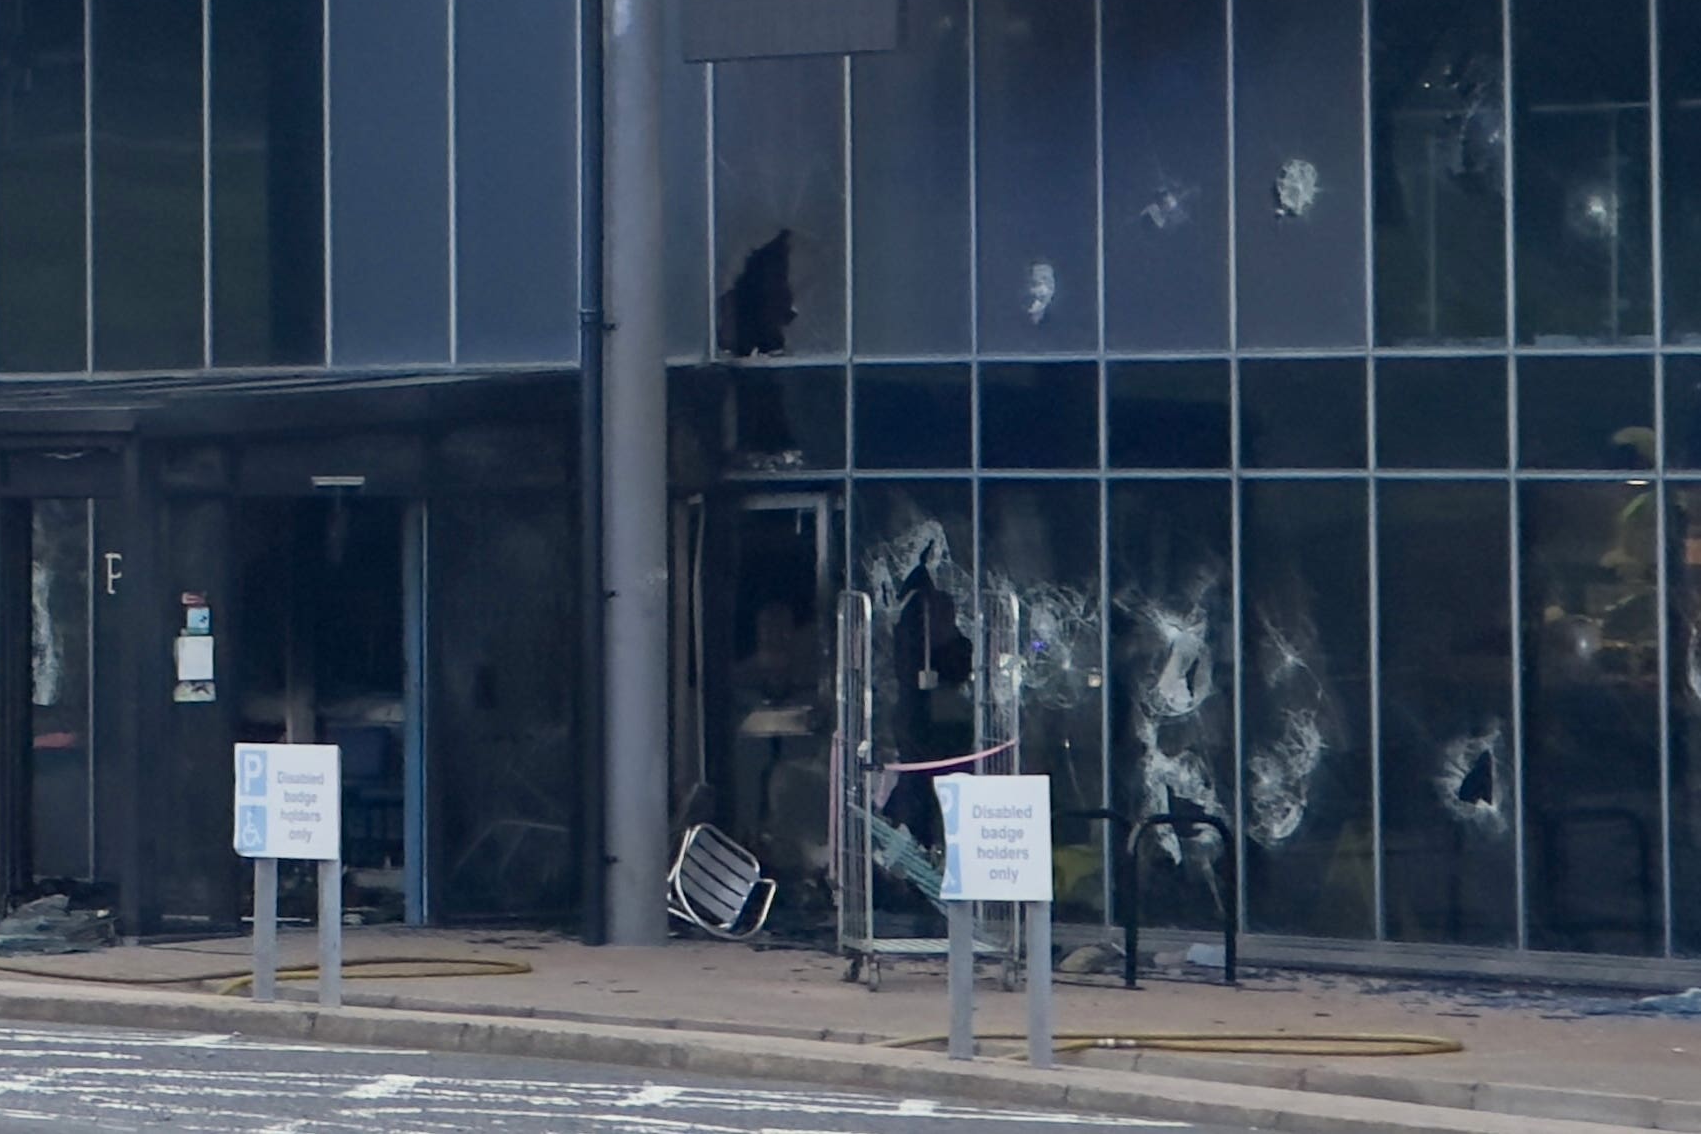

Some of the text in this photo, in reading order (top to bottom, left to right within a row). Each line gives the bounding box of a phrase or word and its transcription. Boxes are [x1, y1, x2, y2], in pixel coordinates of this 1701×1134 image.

[277, 770, 324, 785] Disabled
[283, 790, 318, 807] badge
[280, 809, 322, 823] holders
[972, 804, 1033, 819] Disabled
[288, 827, 313, 844] only
[981, 825, 1025, 843] badge
[976, 846, 1030, 861] holders
[989, 867, 1020, 885] only
